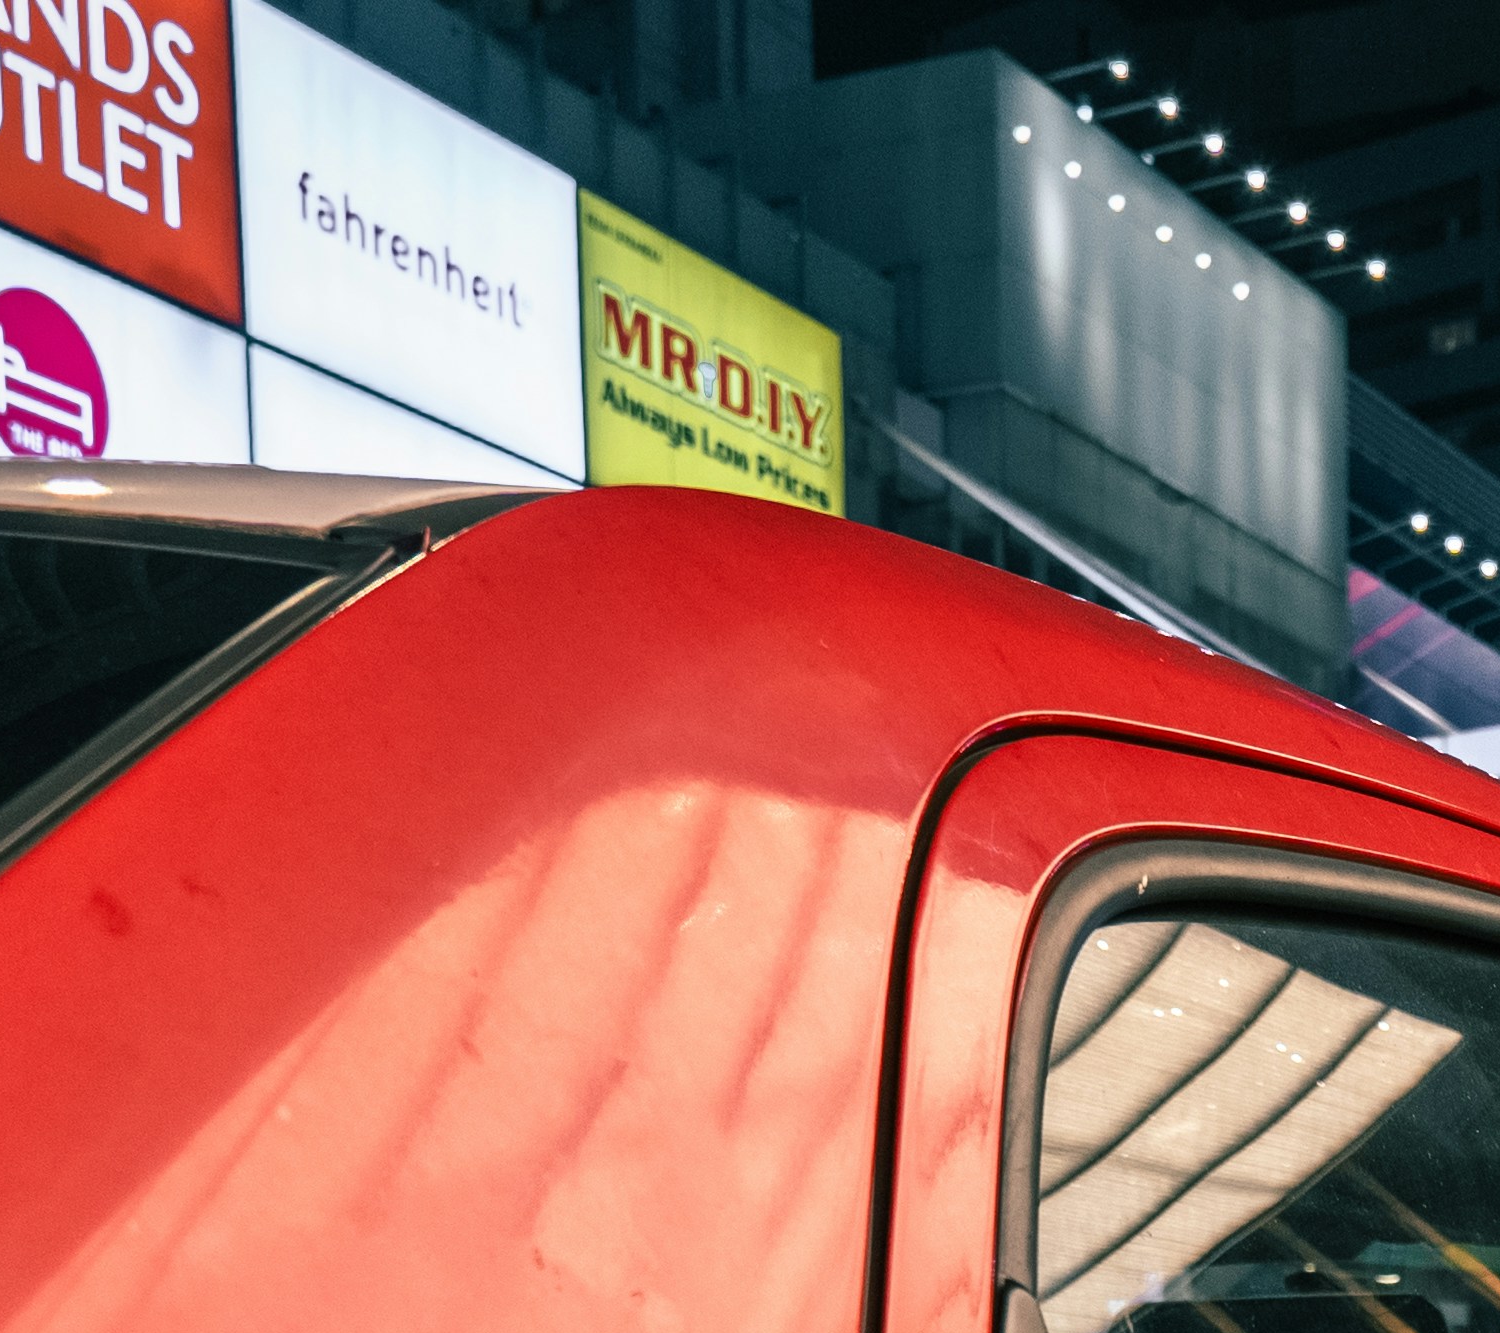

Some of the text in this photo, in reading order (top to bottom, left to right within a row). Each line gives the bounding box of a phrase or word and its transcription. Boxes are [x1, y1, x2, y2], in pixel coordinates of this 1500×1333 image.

[298, 171, 524, 328] fahrenheit
[602, 378, 831, 510] Always Low Prices
